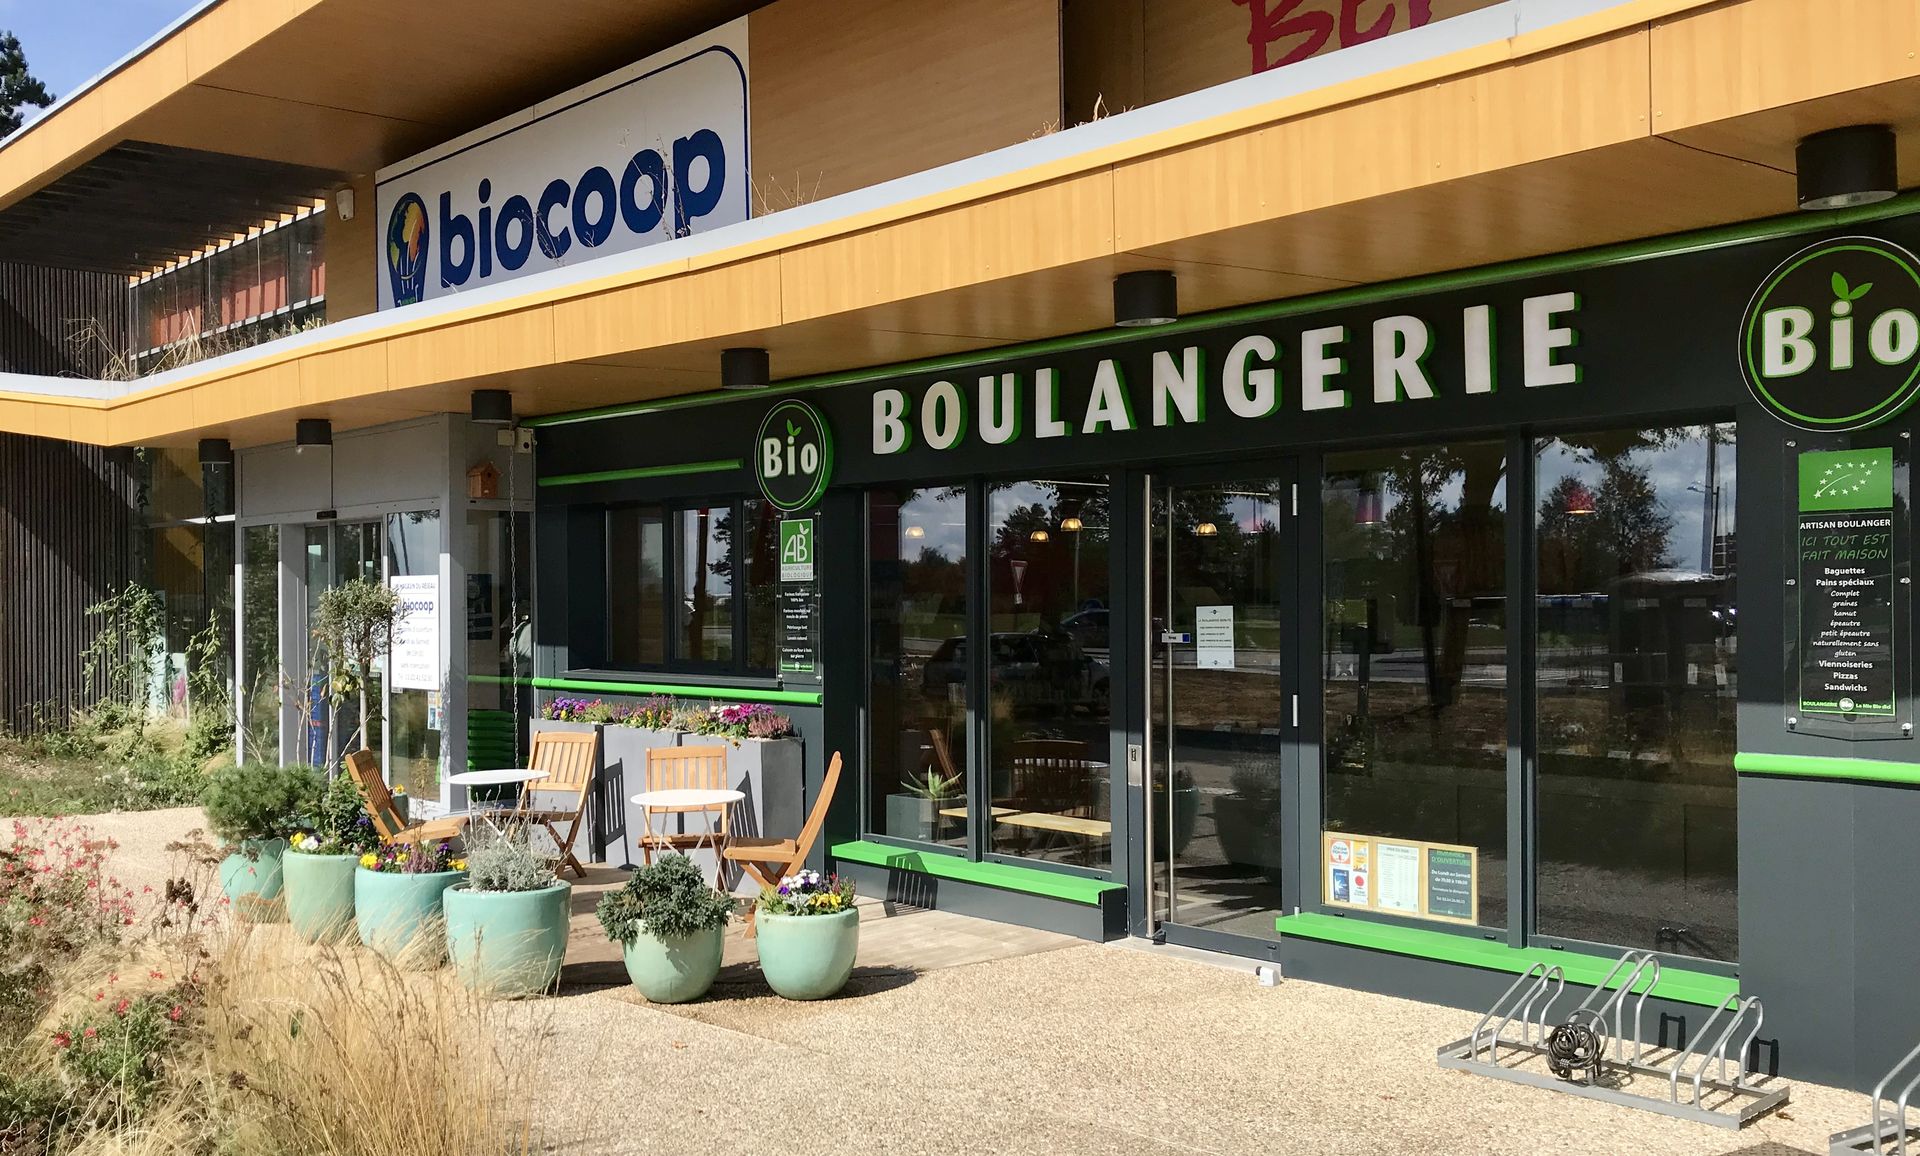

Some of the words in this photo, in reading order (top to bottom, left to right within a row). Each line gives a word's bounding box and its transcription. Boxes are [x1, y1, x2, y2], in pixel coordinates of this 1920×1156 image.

[439, 128, 726, 289] biocoop
[1762, 300, 1920, 378] Bio
[872, 291, 1583, 455] BOULANGERIE
[763, 435, 818, 478] Bio
[1800, 521, 1836, 530] ARTISAN
[1837, 519, 1891, 528] BOULANGER
[1801, 536, 1817, 546] ICI
[1823, 534, 1859, 546] TOUT
[1863, 533, 1890, 545] EST
[783, 534, 808, 562] AB
[1802, 549, 1832, 561] FAIT
[1834, 548, 1889, 560] MAISON
[1824, 567, 1866, 576] Baguettes
[1838, 578, 1875, 587] spéciaux
[1830, 590, 1860, 598] Complet
[1832, 600, 1858, 609] graines
[1830, 620, 1861, 628] épeautre
[1820, 630, 1838, 638] petit
[1839, 629, 1871, 639] épeautre
[1812, 639, 1862, 647] naturellement
[1834, 649, 1857, 658] gluten
[1818, 660, 1873, 669] Viennoiseries
[1833, 672, 1859, 680] Pizzas
[1824, 683, 1868, 692] Sandwichs
